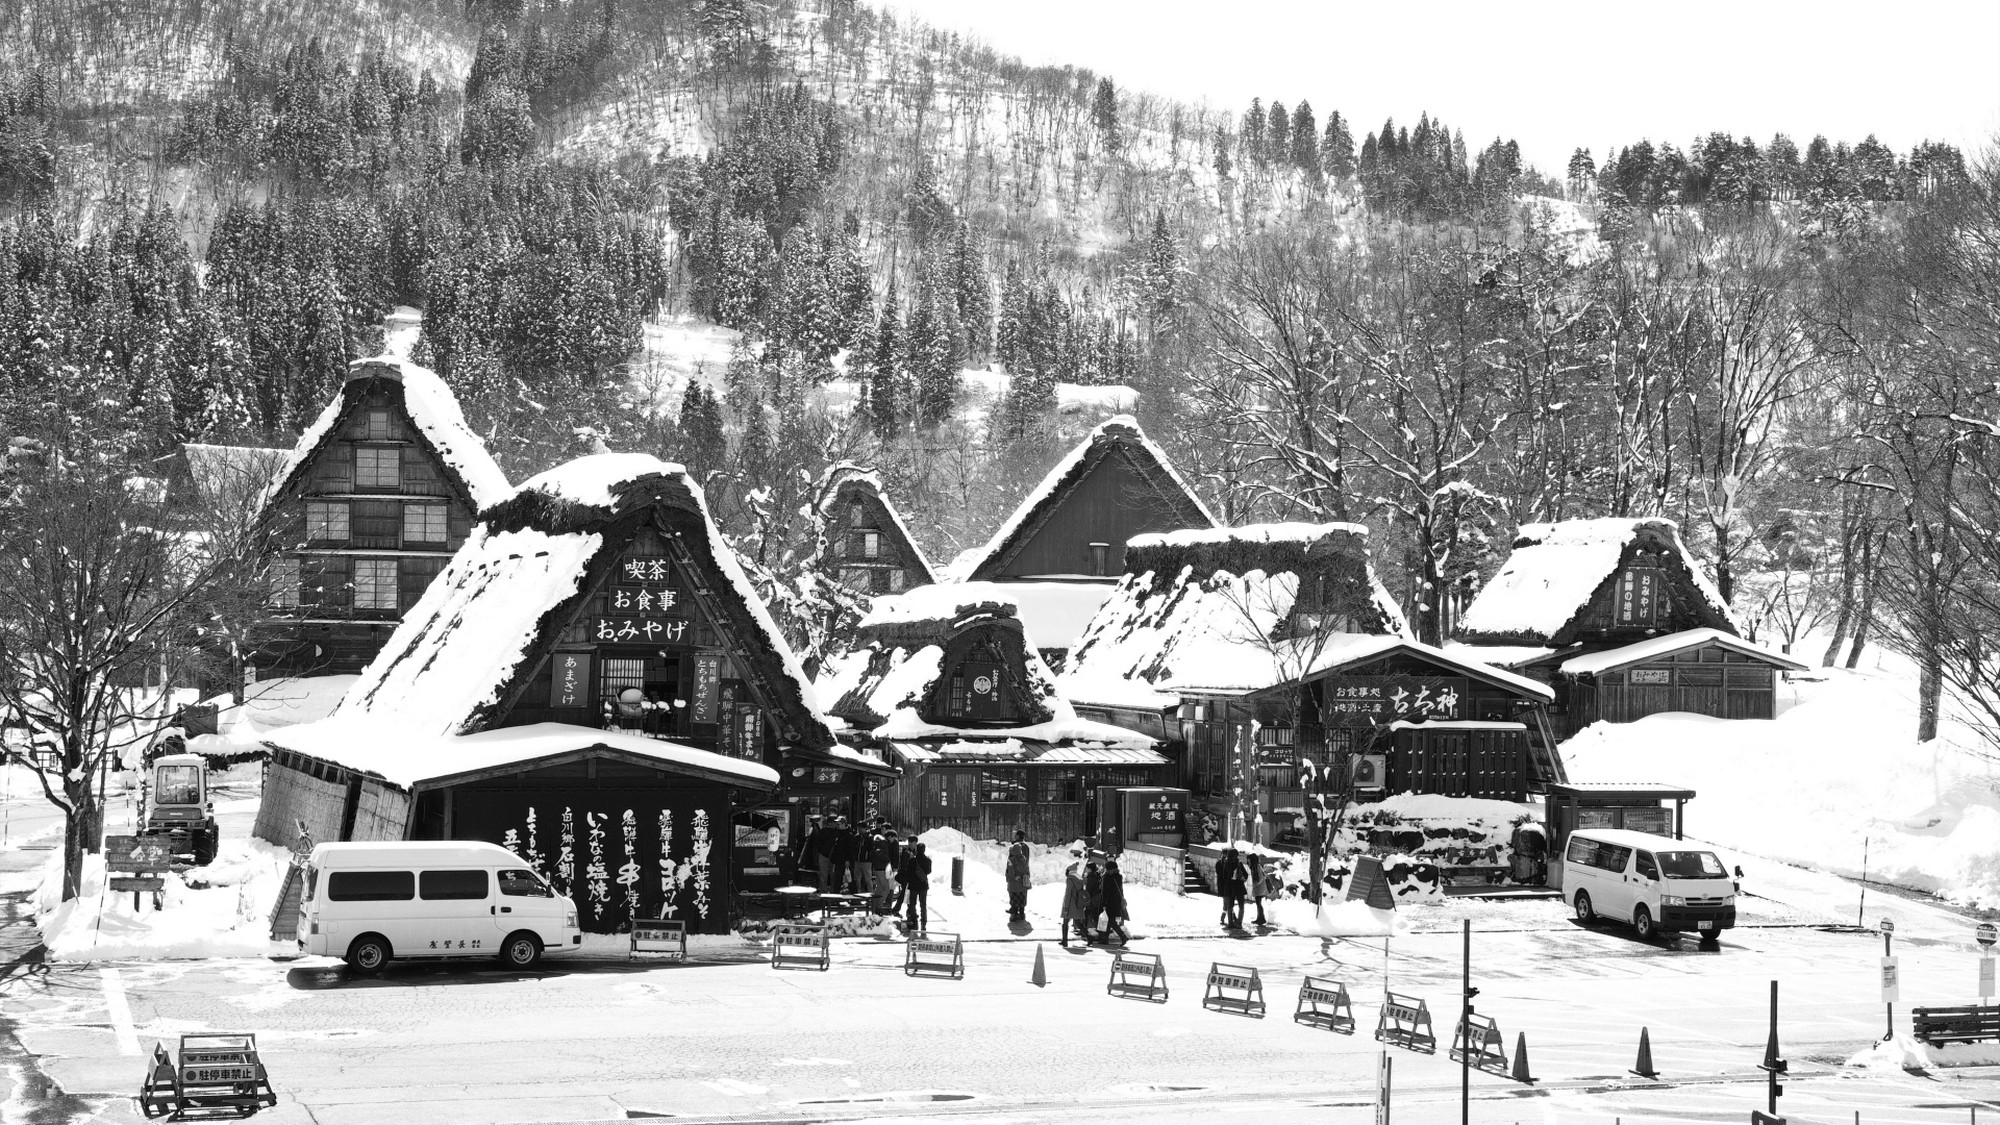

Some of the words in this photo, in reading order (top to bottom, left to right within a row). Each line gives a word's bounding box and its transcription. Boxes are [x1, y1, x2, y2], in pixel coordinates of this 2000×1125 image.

[625, 558, 668, 581] 喫茶
[614, 588, 677, 612] お食事
[1639, 575, 1651, 618] おみやげ
[597, 620, 690, 643] おみやげ
[562, 656, 578, 704] あまざけ
[694, 659, 709, 721] とちもちぜんざい
[1336, 686, 1381, 698] お食事処
[866, 780, 879, 829] おみやげ
[1150, 811, 1176, 821] 地酒
[586, 811, 611, 921] いわなの塩焼き
[786, 937, 820, 946] 駐車禁止
[1217, 976, 1247, 988] 駐車禁止
[199, 1068, 252, 1081] 駐停車禁止
